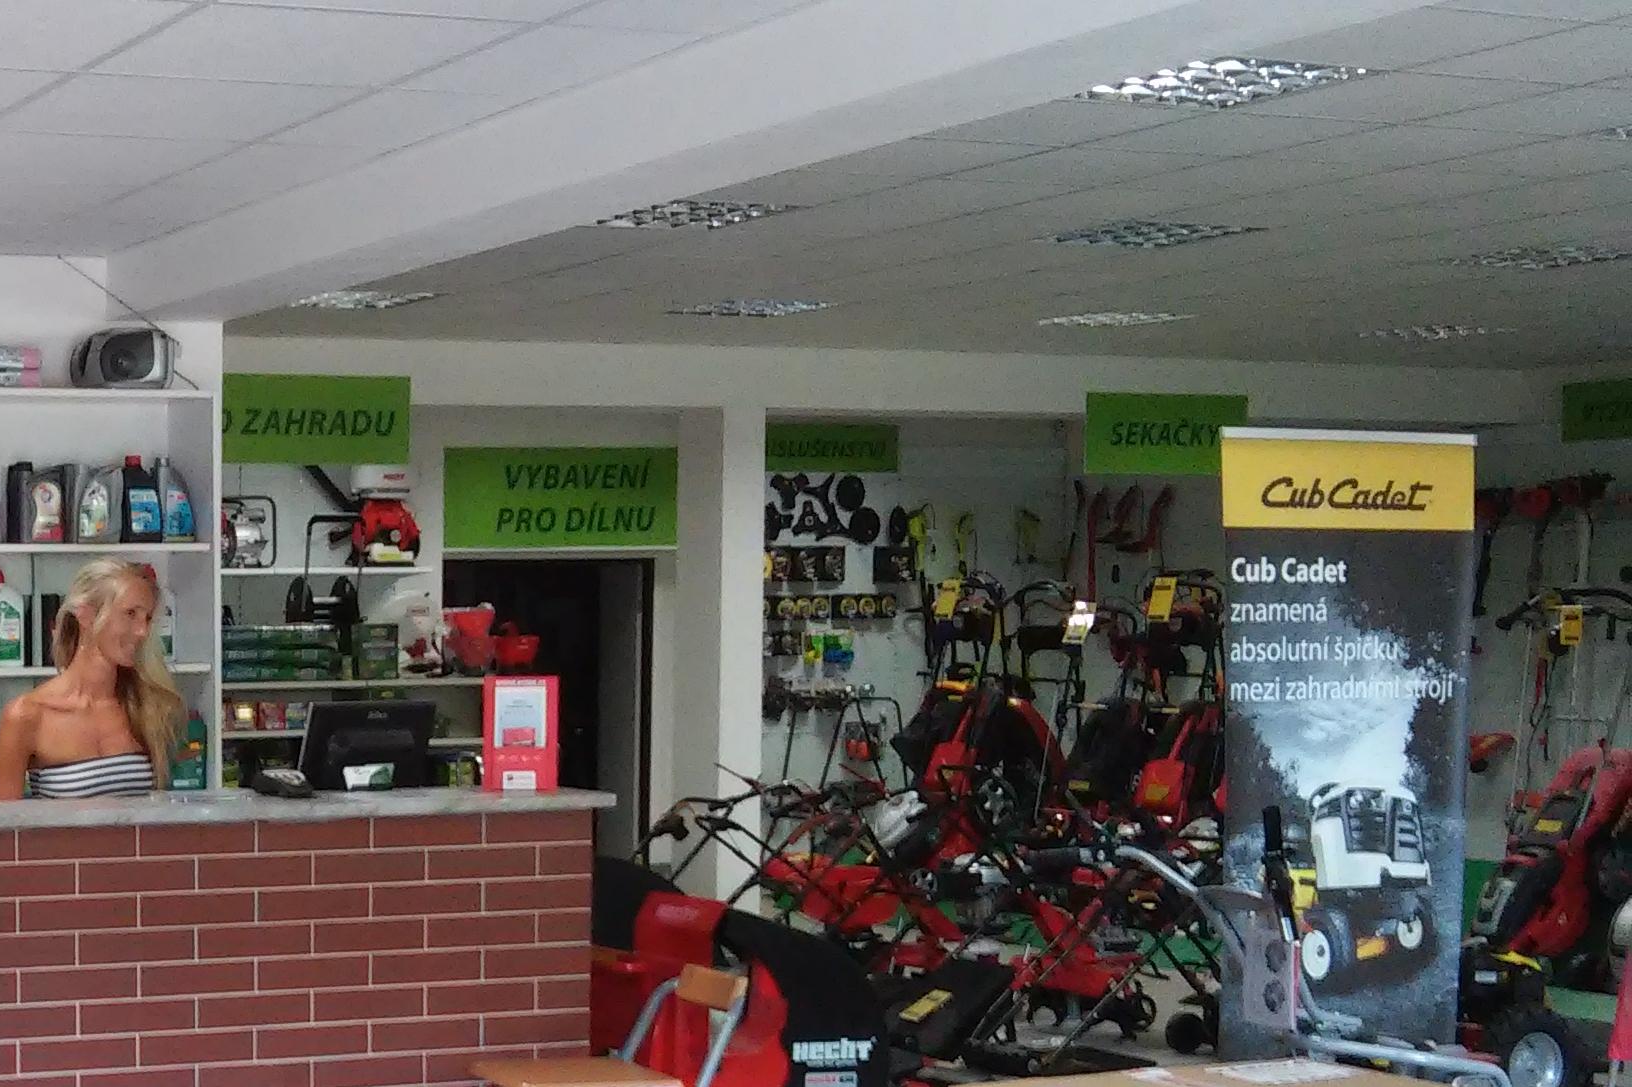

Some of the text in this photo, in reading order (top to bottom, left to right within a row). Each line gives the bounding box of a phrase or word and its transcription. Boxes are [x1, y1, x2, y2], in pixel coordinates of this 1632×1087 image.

[241, 408, 396, 436] ZAHRADU
[1110, 419, 1223, 447] SEKAČKY
[504, 457, 652, 490] VYBAVENÍ
[1261, 476, 1434, 512] Cub Cadet
[496, 502, 657, 533] PRO DÍLNU
[1231, 556, 1348, 583] Cub Cadet
[1230, 597, 1328, 622] znamená
[1230, 636, 1399, 666] absolutní špičku
[1230, 676, 1280, 701] mezi
[1285, 674, 1400, 700] zahradními
[792, 1036, 874, 1062] HECHT
